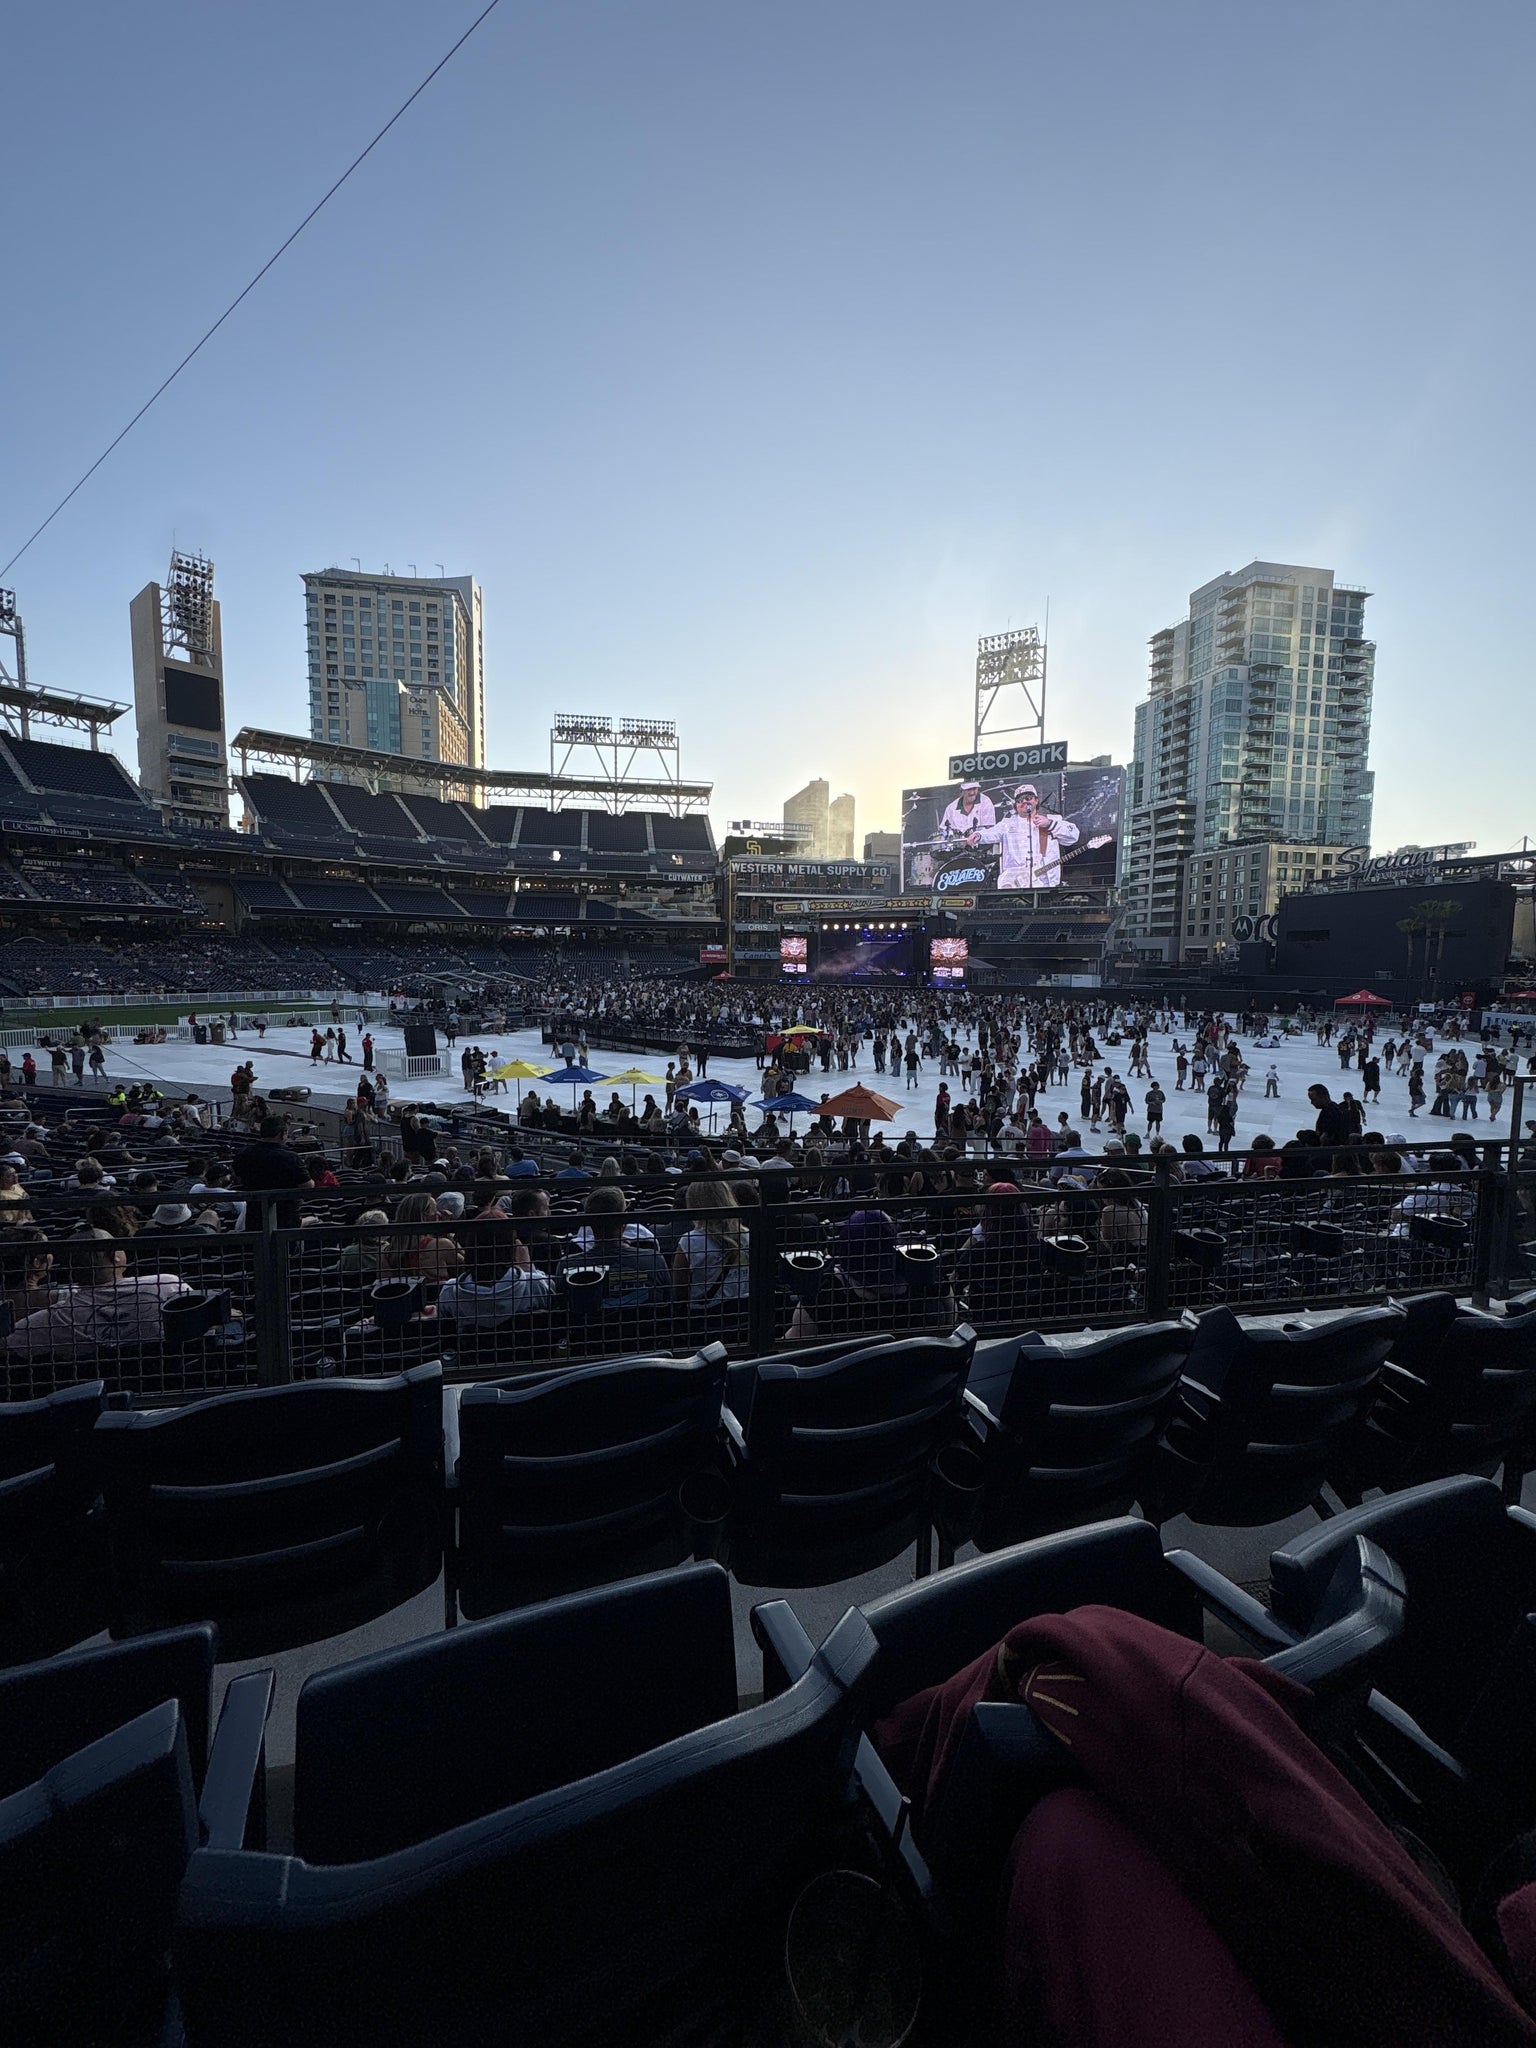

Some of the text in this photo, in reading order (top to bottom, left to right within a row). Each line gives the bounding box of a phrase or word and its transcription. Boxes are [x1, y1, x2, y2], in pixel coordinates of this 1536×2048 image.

[950, 744, 1065, 779] petco park
[25, 824, 39, 832] San
[39, 825, 60, 835] Diego
[60, 827, 82, 836] Health
[23, 858, 61, 867] CUTWATER
[731, 862, 890, 878] WESTERN METAL SUPPLY CO.
[1335, 844, 1434, 880] Sycuan
